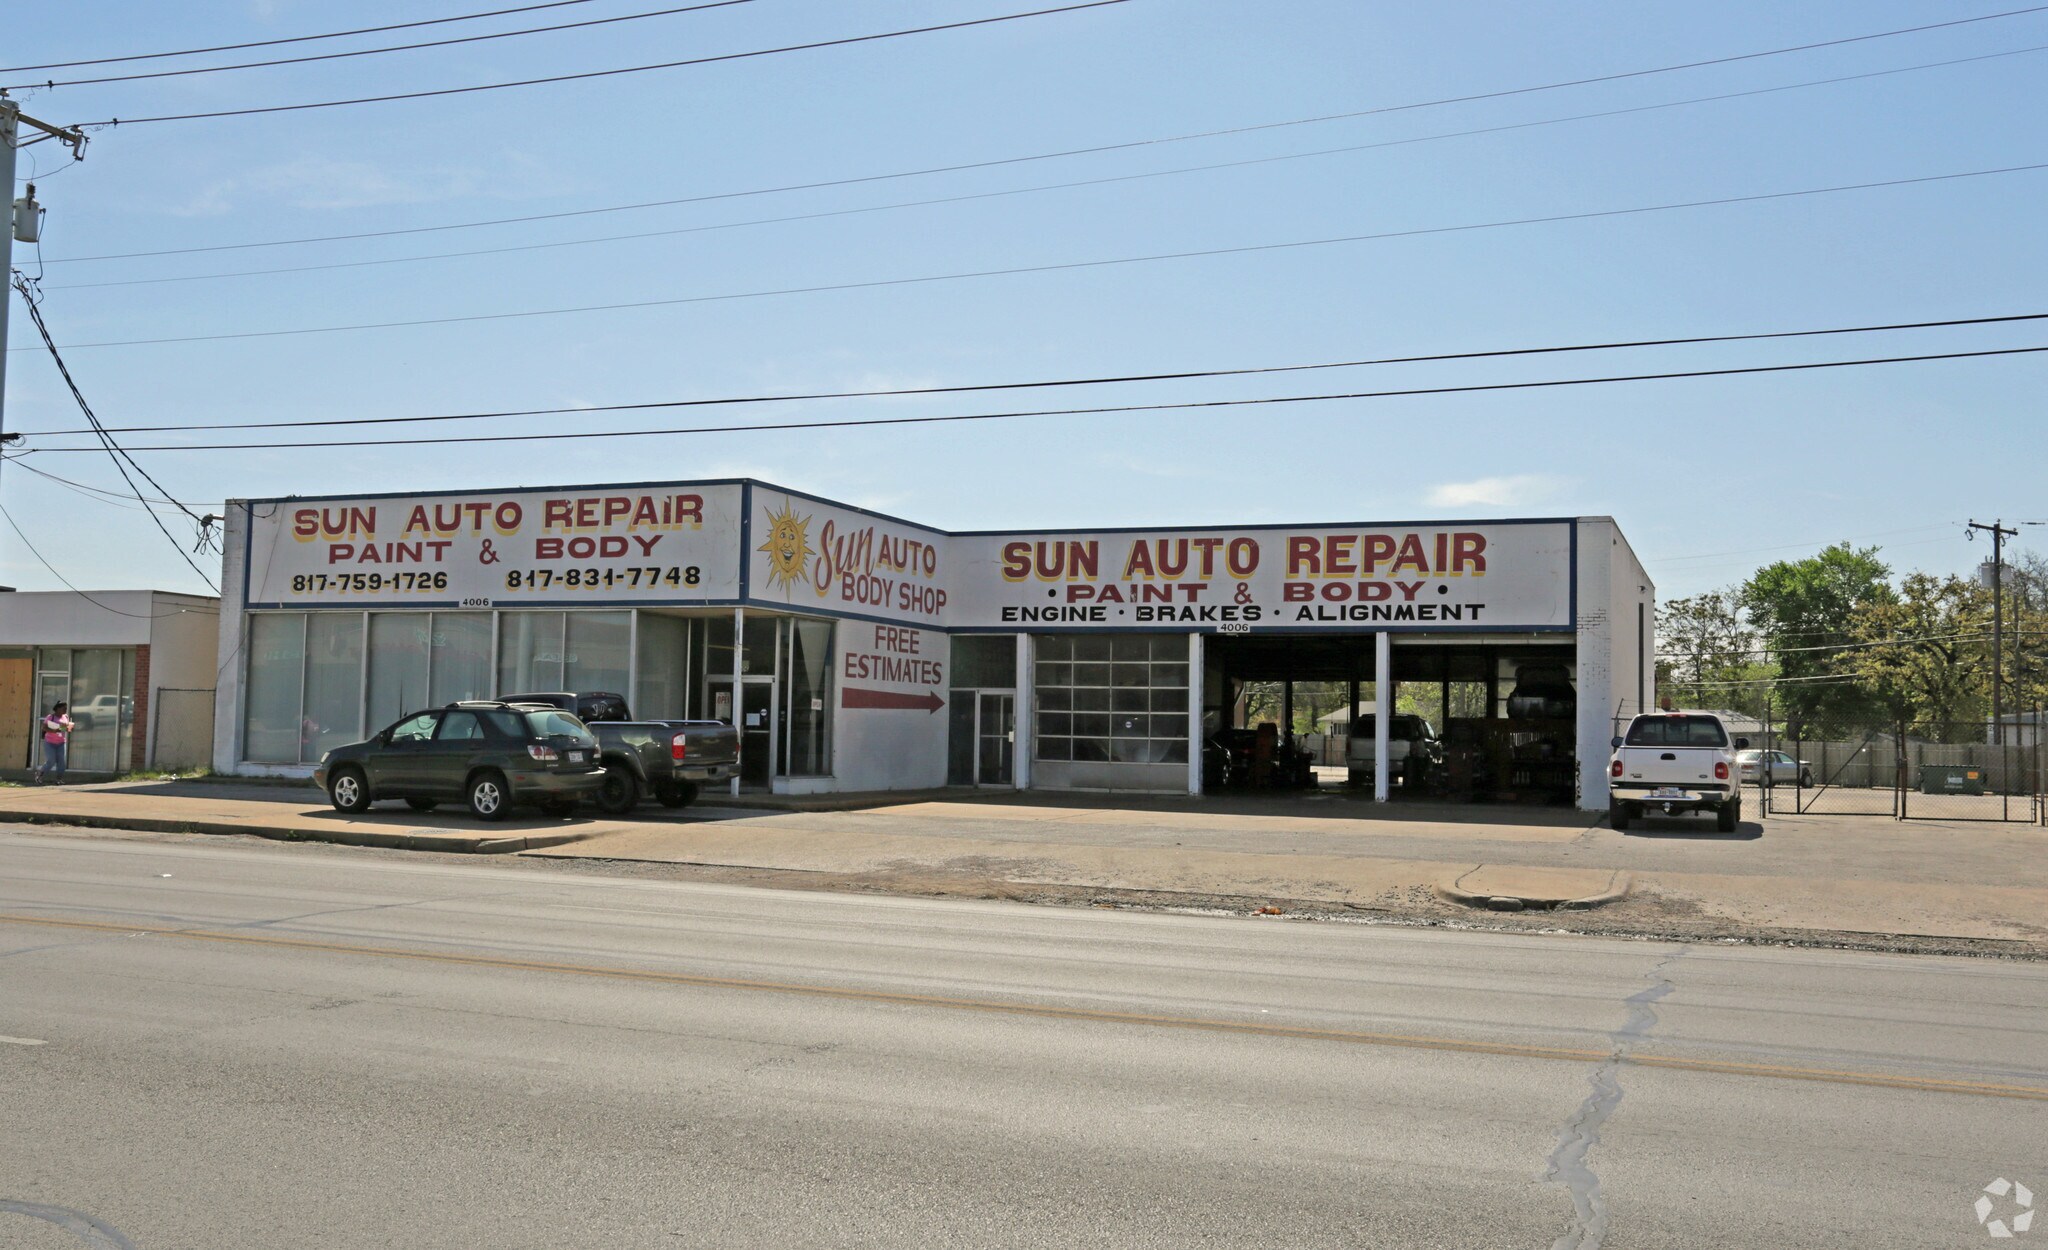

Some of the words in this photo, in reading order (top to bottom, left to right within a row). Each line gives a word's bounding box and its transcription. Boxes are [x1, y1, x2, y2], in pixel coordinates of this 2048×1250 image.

[293, 506, 377, 540] SUN
[403, 502, 522, 537] AUTO
[544, 494, 704, 531] REPAIR
[329, 541, 453, 564] PAINT
[479, 538, 501, 565] &
[535, 534, 664, 559] BODY
[814, 519, 876, 593] Sun
[878, 534, 937, 575] AUTO
[1002, 540, 1099, 580] SUN
[1127, 537, 1261, 578] AUTO
[1288, 532, 1487, 575] REPAIR
[293, 571, 448, 592] 817-759-1726
[507, 566, 702, 588] 817-831-7748
[841, 570, 894, 605] BODY
[899, 582, 947, 615] SHOP
[1067, 583, 1208, 604] PAINT
[1233, 582, 1253, 605] &
[1283, 581, 1426, 602] BODY
[462, 598, 489, 606] 4006
[1001, 605, 1108, 622] ENGINE
[1136, 605, 1262, 622] BRAKES
[1295, 603, 1486, 622] ALIGNMENT
[875, 625, 920, 655] FREE
[1220, 623, 1249, 632] 4006
[844, 652, 943, 685] ESTIMATES
